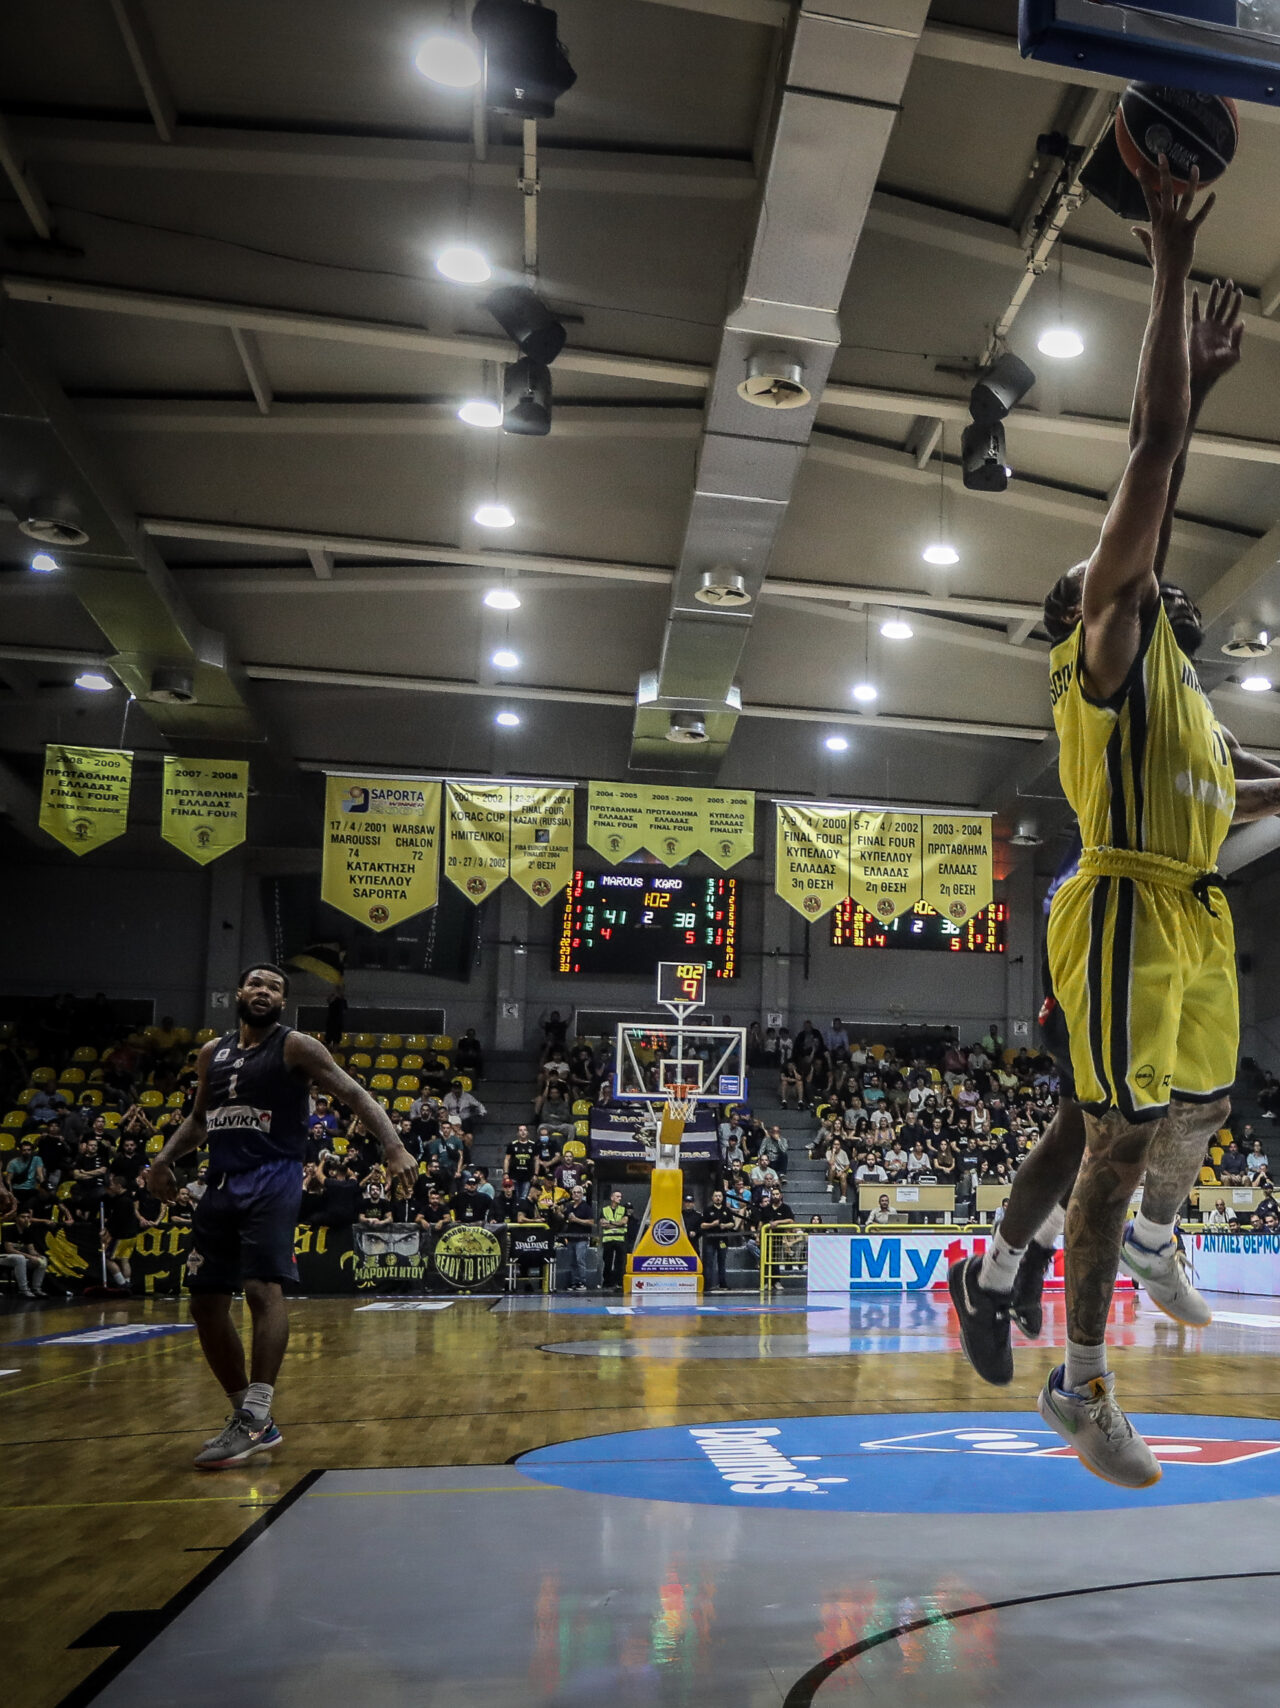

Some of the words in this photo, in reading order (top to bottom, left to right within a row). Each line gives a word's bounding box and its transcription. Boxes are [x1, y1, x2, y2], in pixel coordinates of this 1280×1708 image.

[56, 755, 83, 765] 2008
[94, 759, 121, 768] 2009
[46, 769, 127, 783] ΠΡΩΤΑΘΛΗΜΑ
[175, 770, 200, 778] 2007
[212, 772, 238, 780] 2008
[58, 780, 113, 791] ΕΛΛΑΔΑΣ
[50, 789, 84, 800] FINAL
[88, 791, 119, 802] FOUR
[165, 788, 245, 799] ΠΡΩΤΑΘΛΗΜΑ
[371, 788, 425, 801] SAPORTA
[178, 799, 231, 808] ΕΛΛΑΔΑΣ
[590, 805, 642, 814] ΠΡΩΤΑΘΛΗΜΑ
[171, 808, 204, 817] FINAL
[207, 809, 238, 818] FOUR
[450, 811, 484, 821] KORAC
[486, 812, 506, 822] CUP
[522, 806, 543, 814] FINAL
[545, 807, 564, 815] FOUR
[646, 808, 698, 817] ΠΡΩΤΑΘΛΗΜΑ
[709, 812, 745, 820] ΚΥΠΕΛΛΟ
[514, 817, 538, 825] KAZAN
[539, 818, 571, 827] (RUSSIA)
[598, 813, 633, 821] ΕΛΛΑΔΑΣ
[654, 816, 689, 824] ΕΛΛΑΔΑΣ
[365, 823, 386, 832] 2001
[392, 824, 435, 835] WARSAW
[593, 820, 615, 828] FINAL
[650, 823, 671, 831] FINAL
[822, 818, 847, 829] 2000
[895, 822, 919, 833] 2002
[933, 824, 955, 835] 2003
[962, 824, 982, 835] 2004
[331, 834, 381, 846] MAROUSSI
[396, 838, 433, 847] CHALON
[451, 831, 504, 842] ΗΜΙΤΕΛΙΚΟΙ
[784, 831, 812, 843] FINAL
[816, 833, 843, 844] FOUR
[857, 836, 885, 847] FINAL
[889, 837, 915, 848] FOUR
[348, 848, 359, 858] 74
[412, 851, 423, 860] 72
[786, 846, 840, 860] ΚΥΠΕΛΛΟΥ
[928, 843, 988, 856] ΠΡΩΤΑΘΛΗΜΑ
[860, 851, 912, 863] ΚΥΠΕΛΛΟΥ
[347, 861, 415, 874] ΚΑΤΑΚΤΗΣΗ
[789, 862, 837, 875] ΕΛΛΑΔΑΣ
[863, 866, 909, 878] ΕΛΛΑΔΑΣ
[938, 863, 978, 876] ΕΛΛΑΔΑΣ
[349, 875, 412, 886] ΚΥΠΕΛΛΟΥ
[602, 876, 643, 887] MAROUS
[654, 878, 682, 889] KARD
[791, 877, 804, 890] 3η
[807, 878, 834, 890] ΘΕΣΗ
[353, 888, 407, 899] SAPORTA
[866, 881, 878, 894] 2η
[881, 881, 907, 893] ΘΕΣΗ
[940, 884, 950, 896] 2η
[953, 884, 976, 895] ΘΕΣΗ
[604, 909, 627, 925] 41
[643, 911, 654, 924] 2
[674, 912, 696, 928] 38
[912, 920, 923, 933] 2
[601, 928, 612, 940] 4
[685, 931, 696, 944] 5
[515, 1240, 548, 1250] SPALDING
[1203, 1235, 1241, 1253] ΑΝΤΛΙΕΣ
[437, 1255, 460, 1280] READY
[464, 1258, 473, 1281] TO
[478, 1255, 500, 1280] FIGHT
[642, 1257, 689, 1268] ARENA
[355, 1267, 398, 1280] ΜΑΡΟΥΣΙ
[400, 1267, 425, 1279] ΝΤΟΥ
[689, 1427, 849, 1494] Domino's
